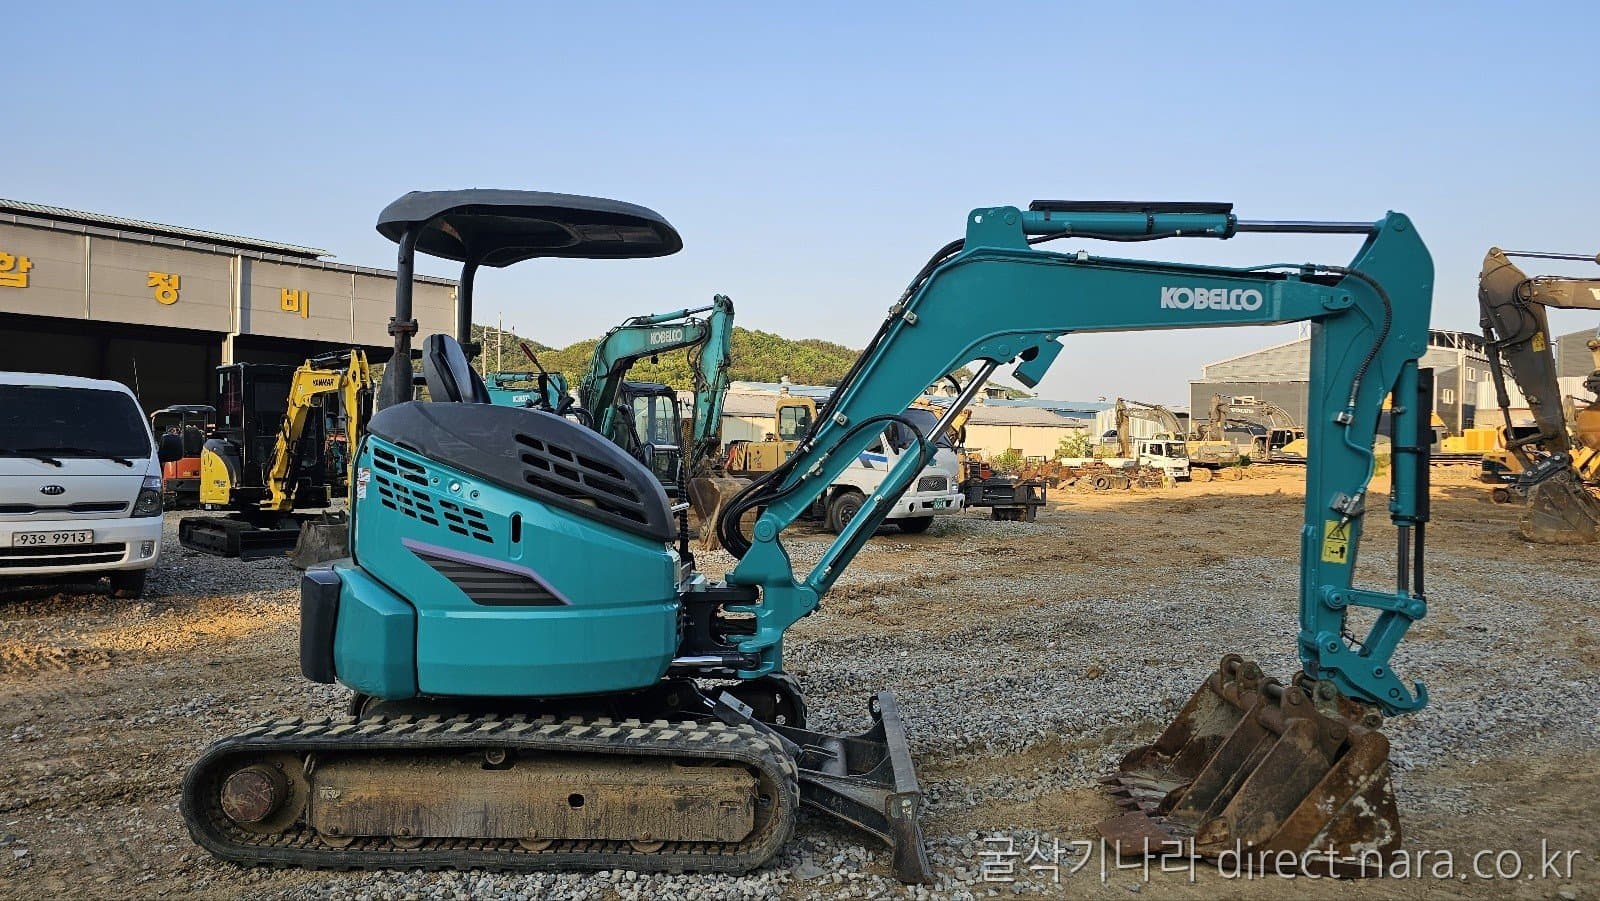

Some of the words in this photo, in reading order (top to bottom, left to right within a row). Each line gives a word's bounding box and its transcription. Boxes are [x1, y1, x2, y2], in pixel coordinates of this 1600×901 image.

[147, 271, 181, 305] 정
[280, 287, 309, 319] 비
[1161, 287, 1263, 311] KOBELCO
[650, 329, 682, 345] KOBELCO
[44, 486, 62, 494] KIA
[20, 534, 47, 545] 93오
[52, 532, 86, 543] 9913
